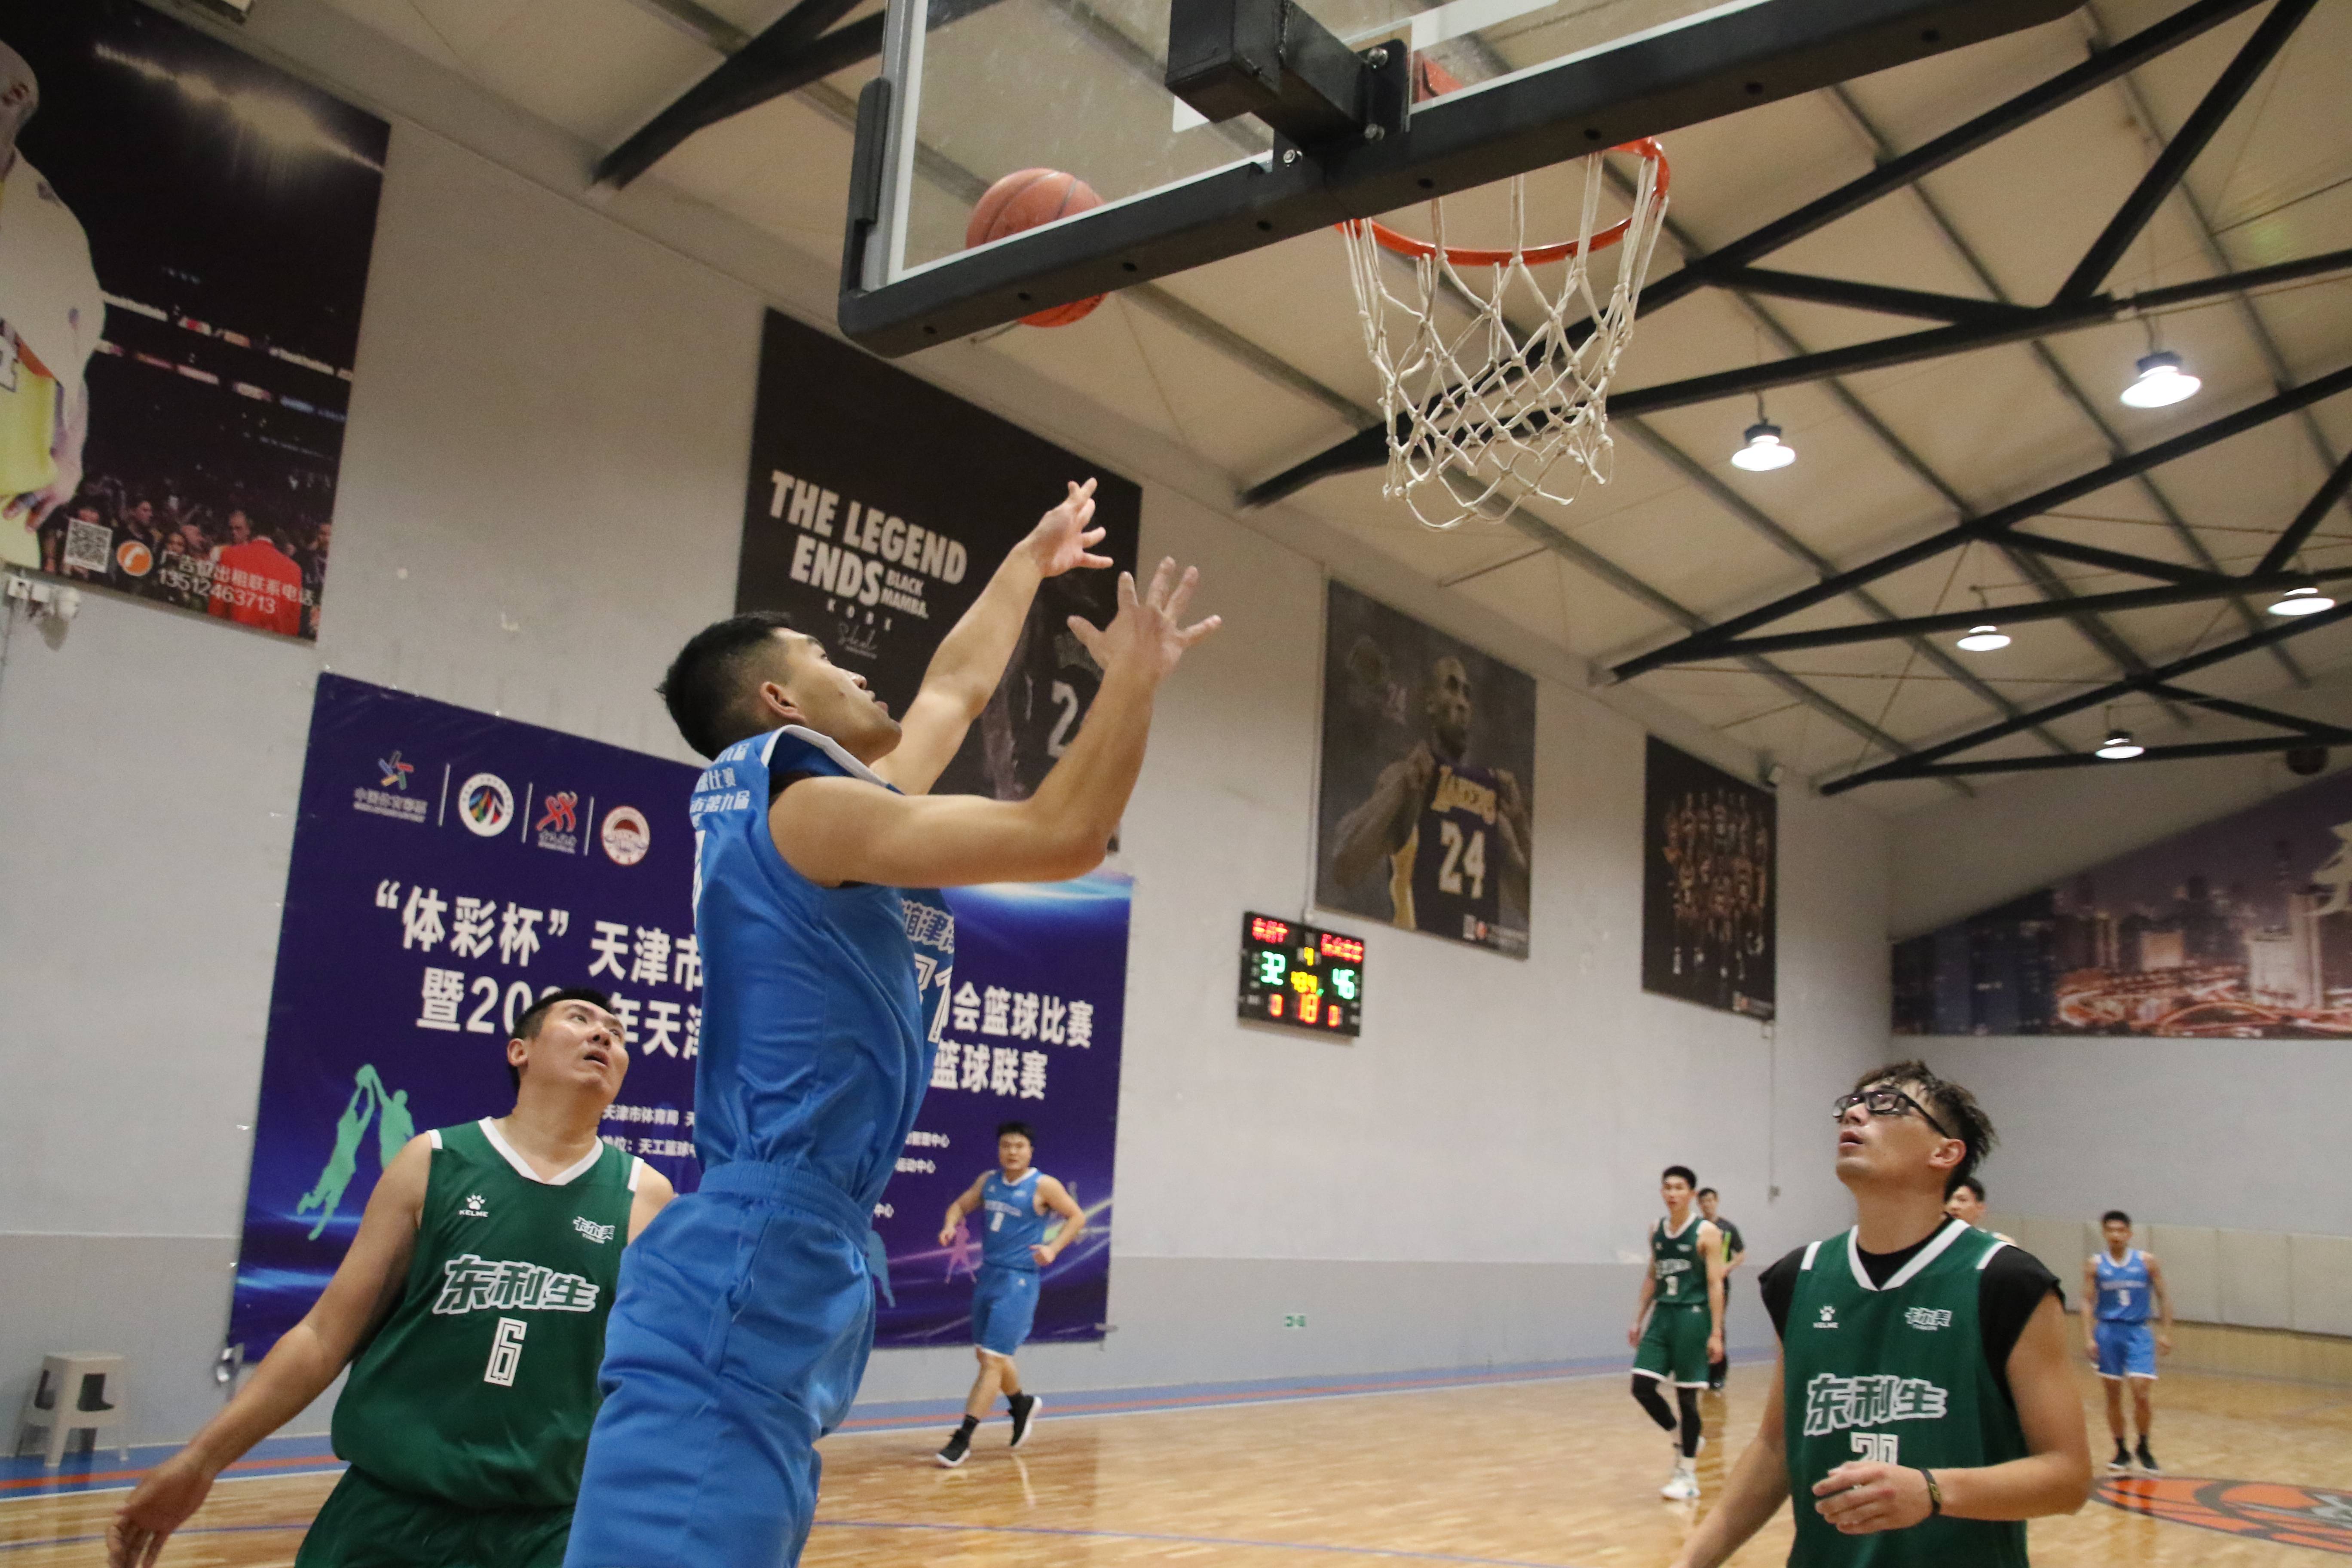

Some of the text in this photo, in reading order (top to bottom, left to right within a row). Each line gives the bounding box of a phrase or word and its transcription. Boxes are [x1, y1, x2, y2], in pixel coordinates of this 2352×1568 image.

[771, 469, 968, 585] THE LEGEND
[159, 550, 312, 606] 广告位出租联系电话
[159, 567, 276, 614] 13512463713
[790, 534, 884, 606] ENDS
[1439, 820, 1486, 899] 24
[952, 981, 1093, 1049] 会篮球比赛
[432, 1254, 600, 1315] 东利生
[484, 1317, 528, 1387] 6
[1804, 1373, 1948, 1436] 东利生
